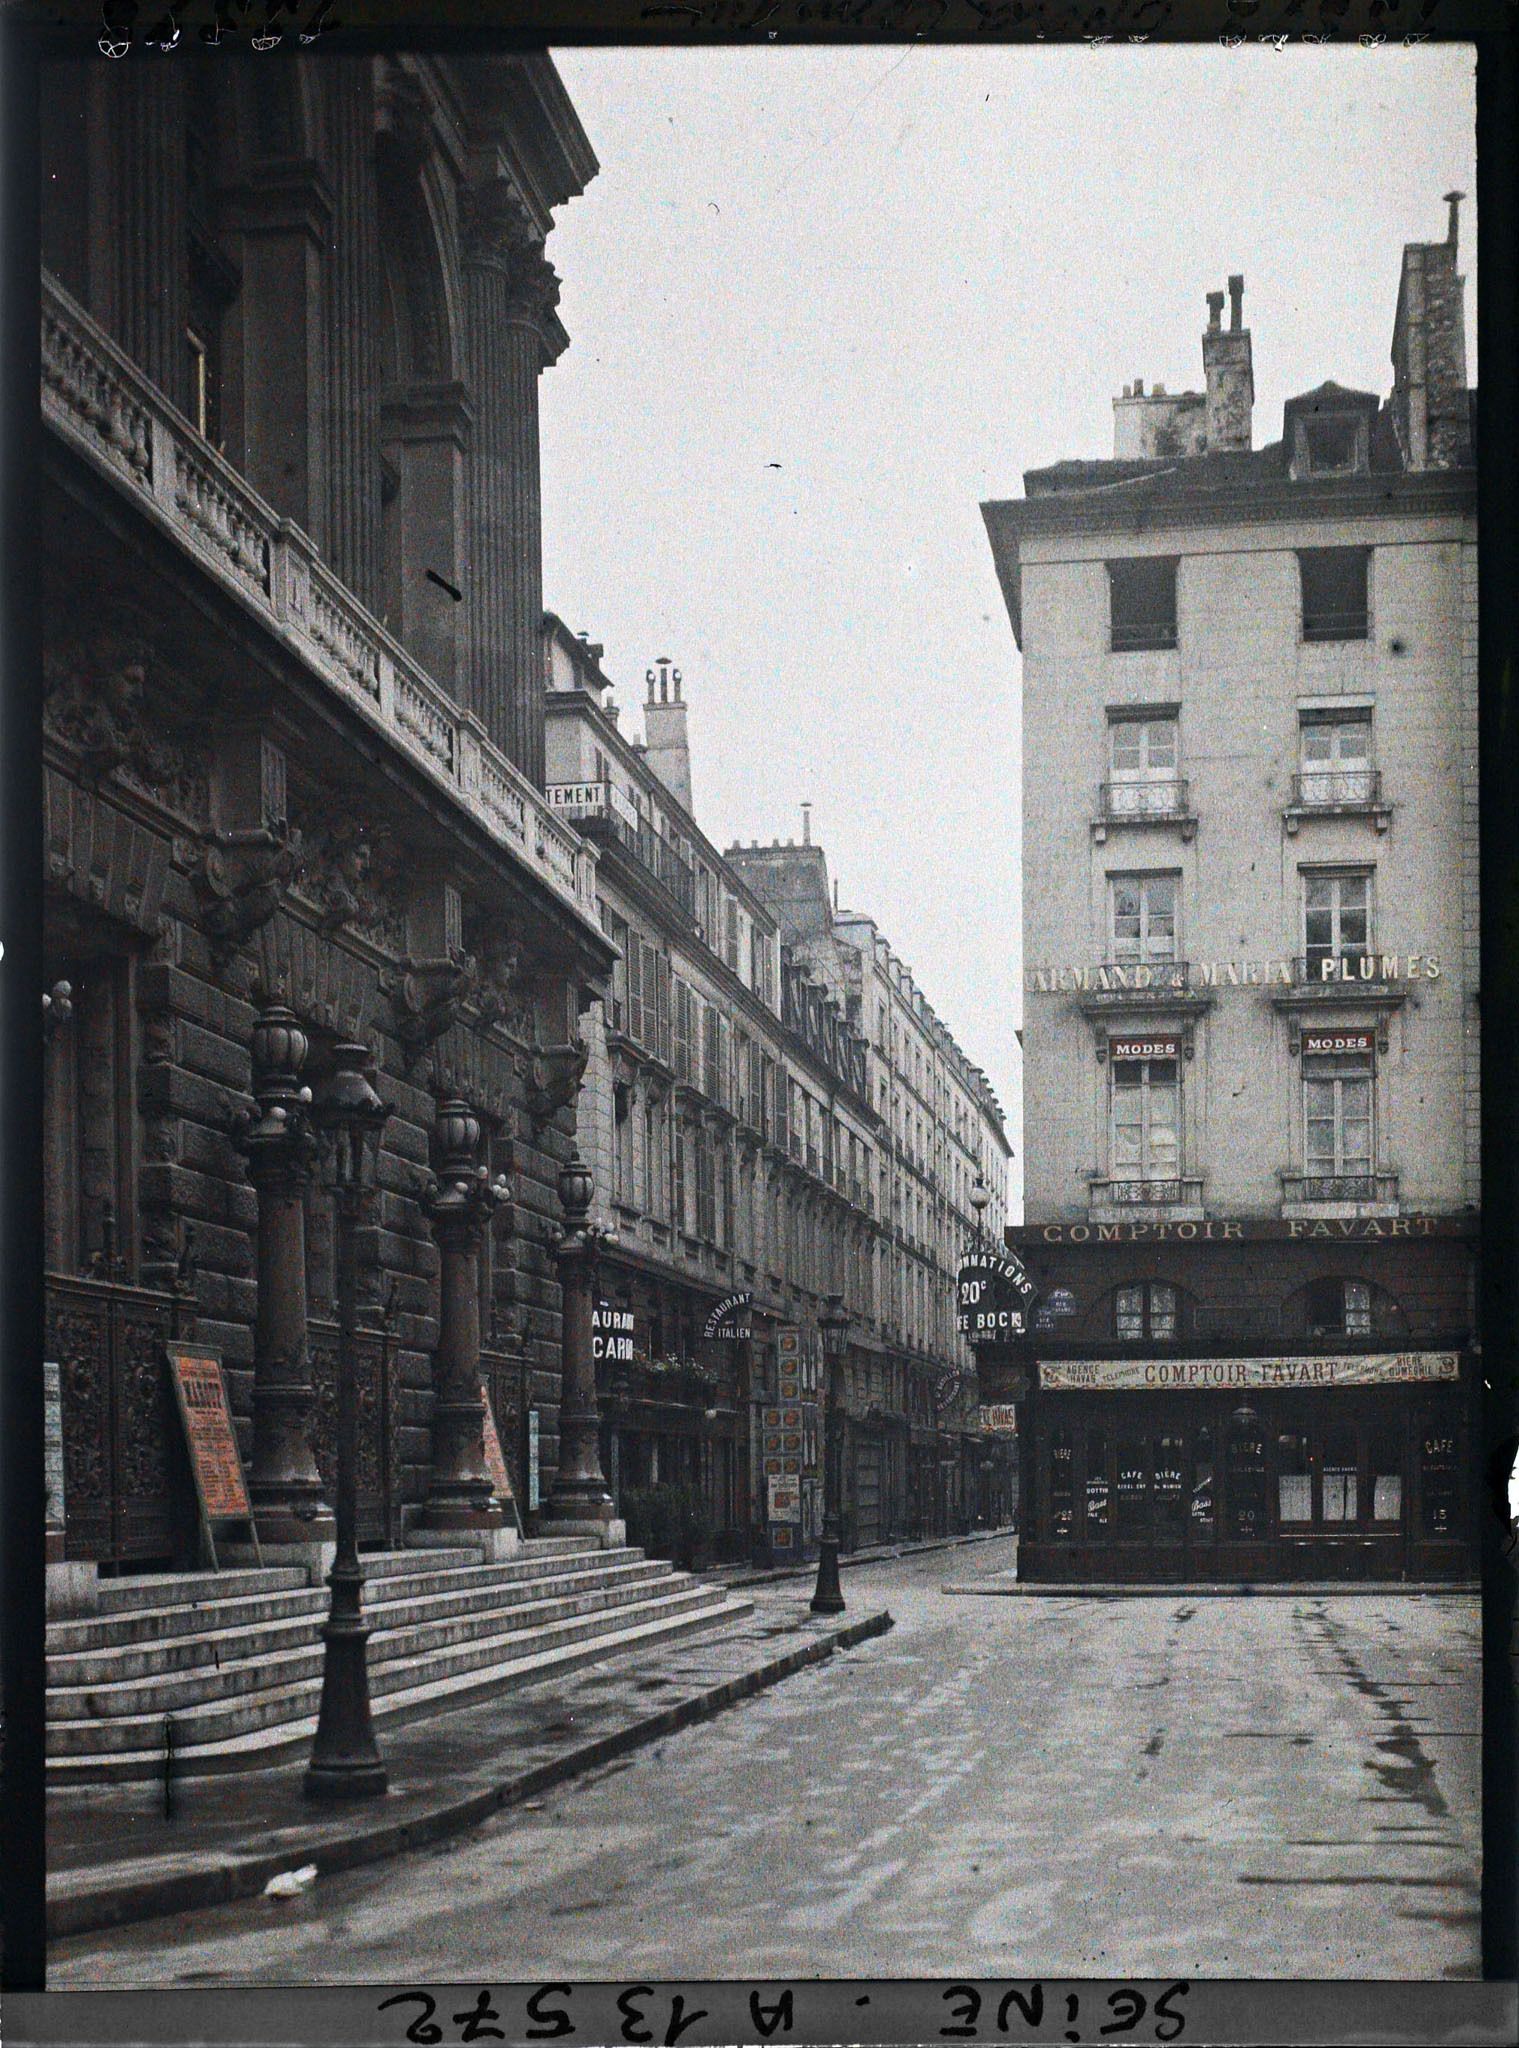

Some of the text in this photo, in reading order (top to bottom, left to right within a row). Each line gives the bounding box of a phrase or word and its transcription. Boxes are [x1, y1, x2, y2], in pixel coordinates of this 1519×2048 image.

[1321, 955, 1441, 982] PLUMES
[1115, 1043, 1176, 1056] MODES
[1307, 1037, 1368, 1049] MODES
[1043, 1218, 1438, 1242] COMPTOIR FAVART
[704, 1292, 751, 1338] RESTAURANT
[977, 1311, 1022, 1329] BOCK
[718, 1328, 751, 1338] ITALIEN
[1067, 1364, 1100, 1375] AGENCE
[1144, 1362, 1338, 1383] COMPTOIR FAVART
[378, 1984, 573, 2046] 572
[617, 1986, 710, 2046] 13
[750, 1990, 793, 2037] A
